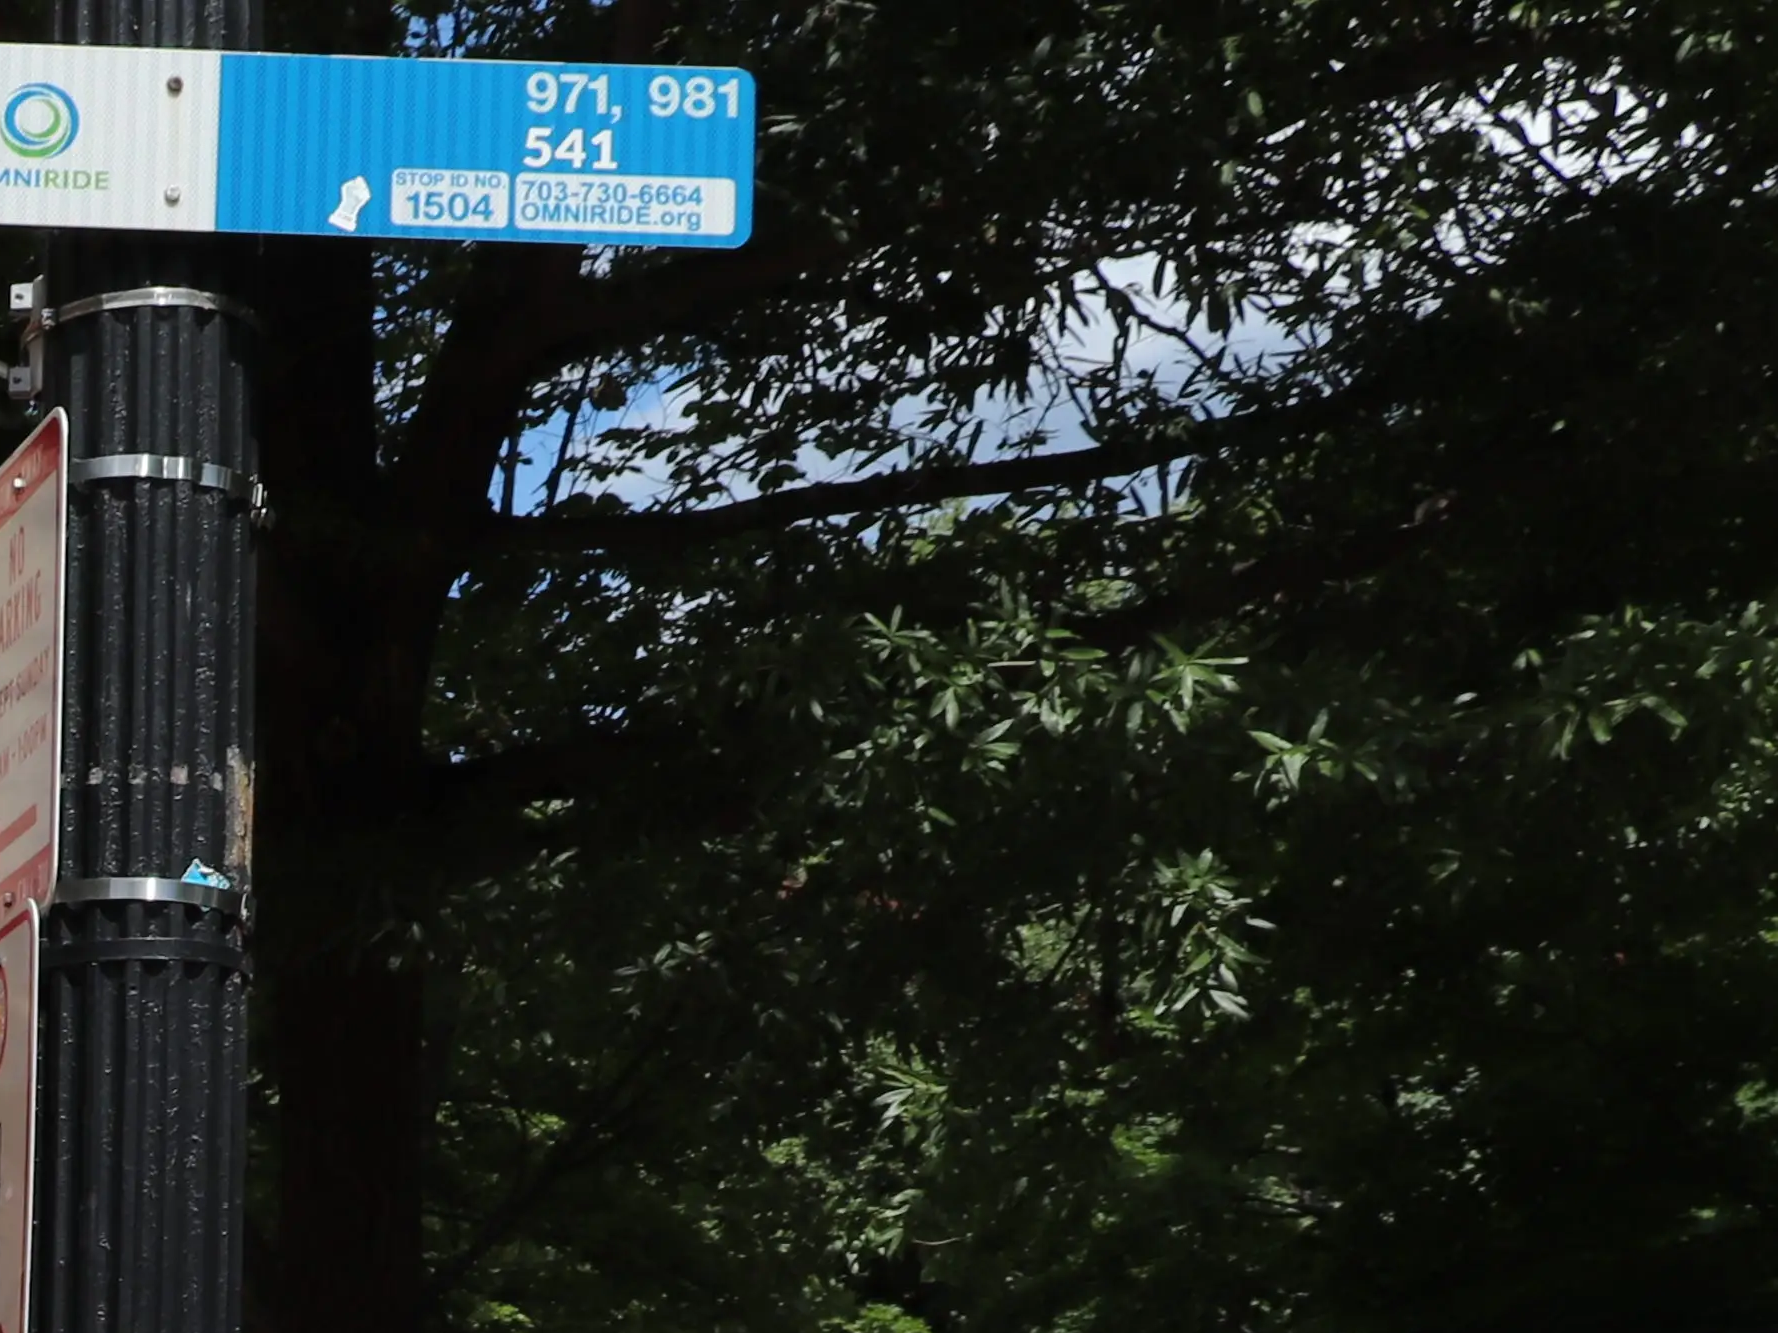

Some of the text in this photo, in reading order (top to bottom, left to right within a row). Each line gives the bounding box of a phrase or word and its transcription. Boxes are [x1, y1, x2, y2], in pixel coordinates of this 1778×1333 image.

[526, 72, 739, 123] 971, 981
[523, 127, 618, 170] 541
[396, 172, 506, 189] STOP ID NO.
[521, 181, 703, 206] 703-730-6664
[406, 192, 493, 222] 1504
[521, 202, 702, 231] OMNIRIDE.org
[9, 526, 24, 585] NO
